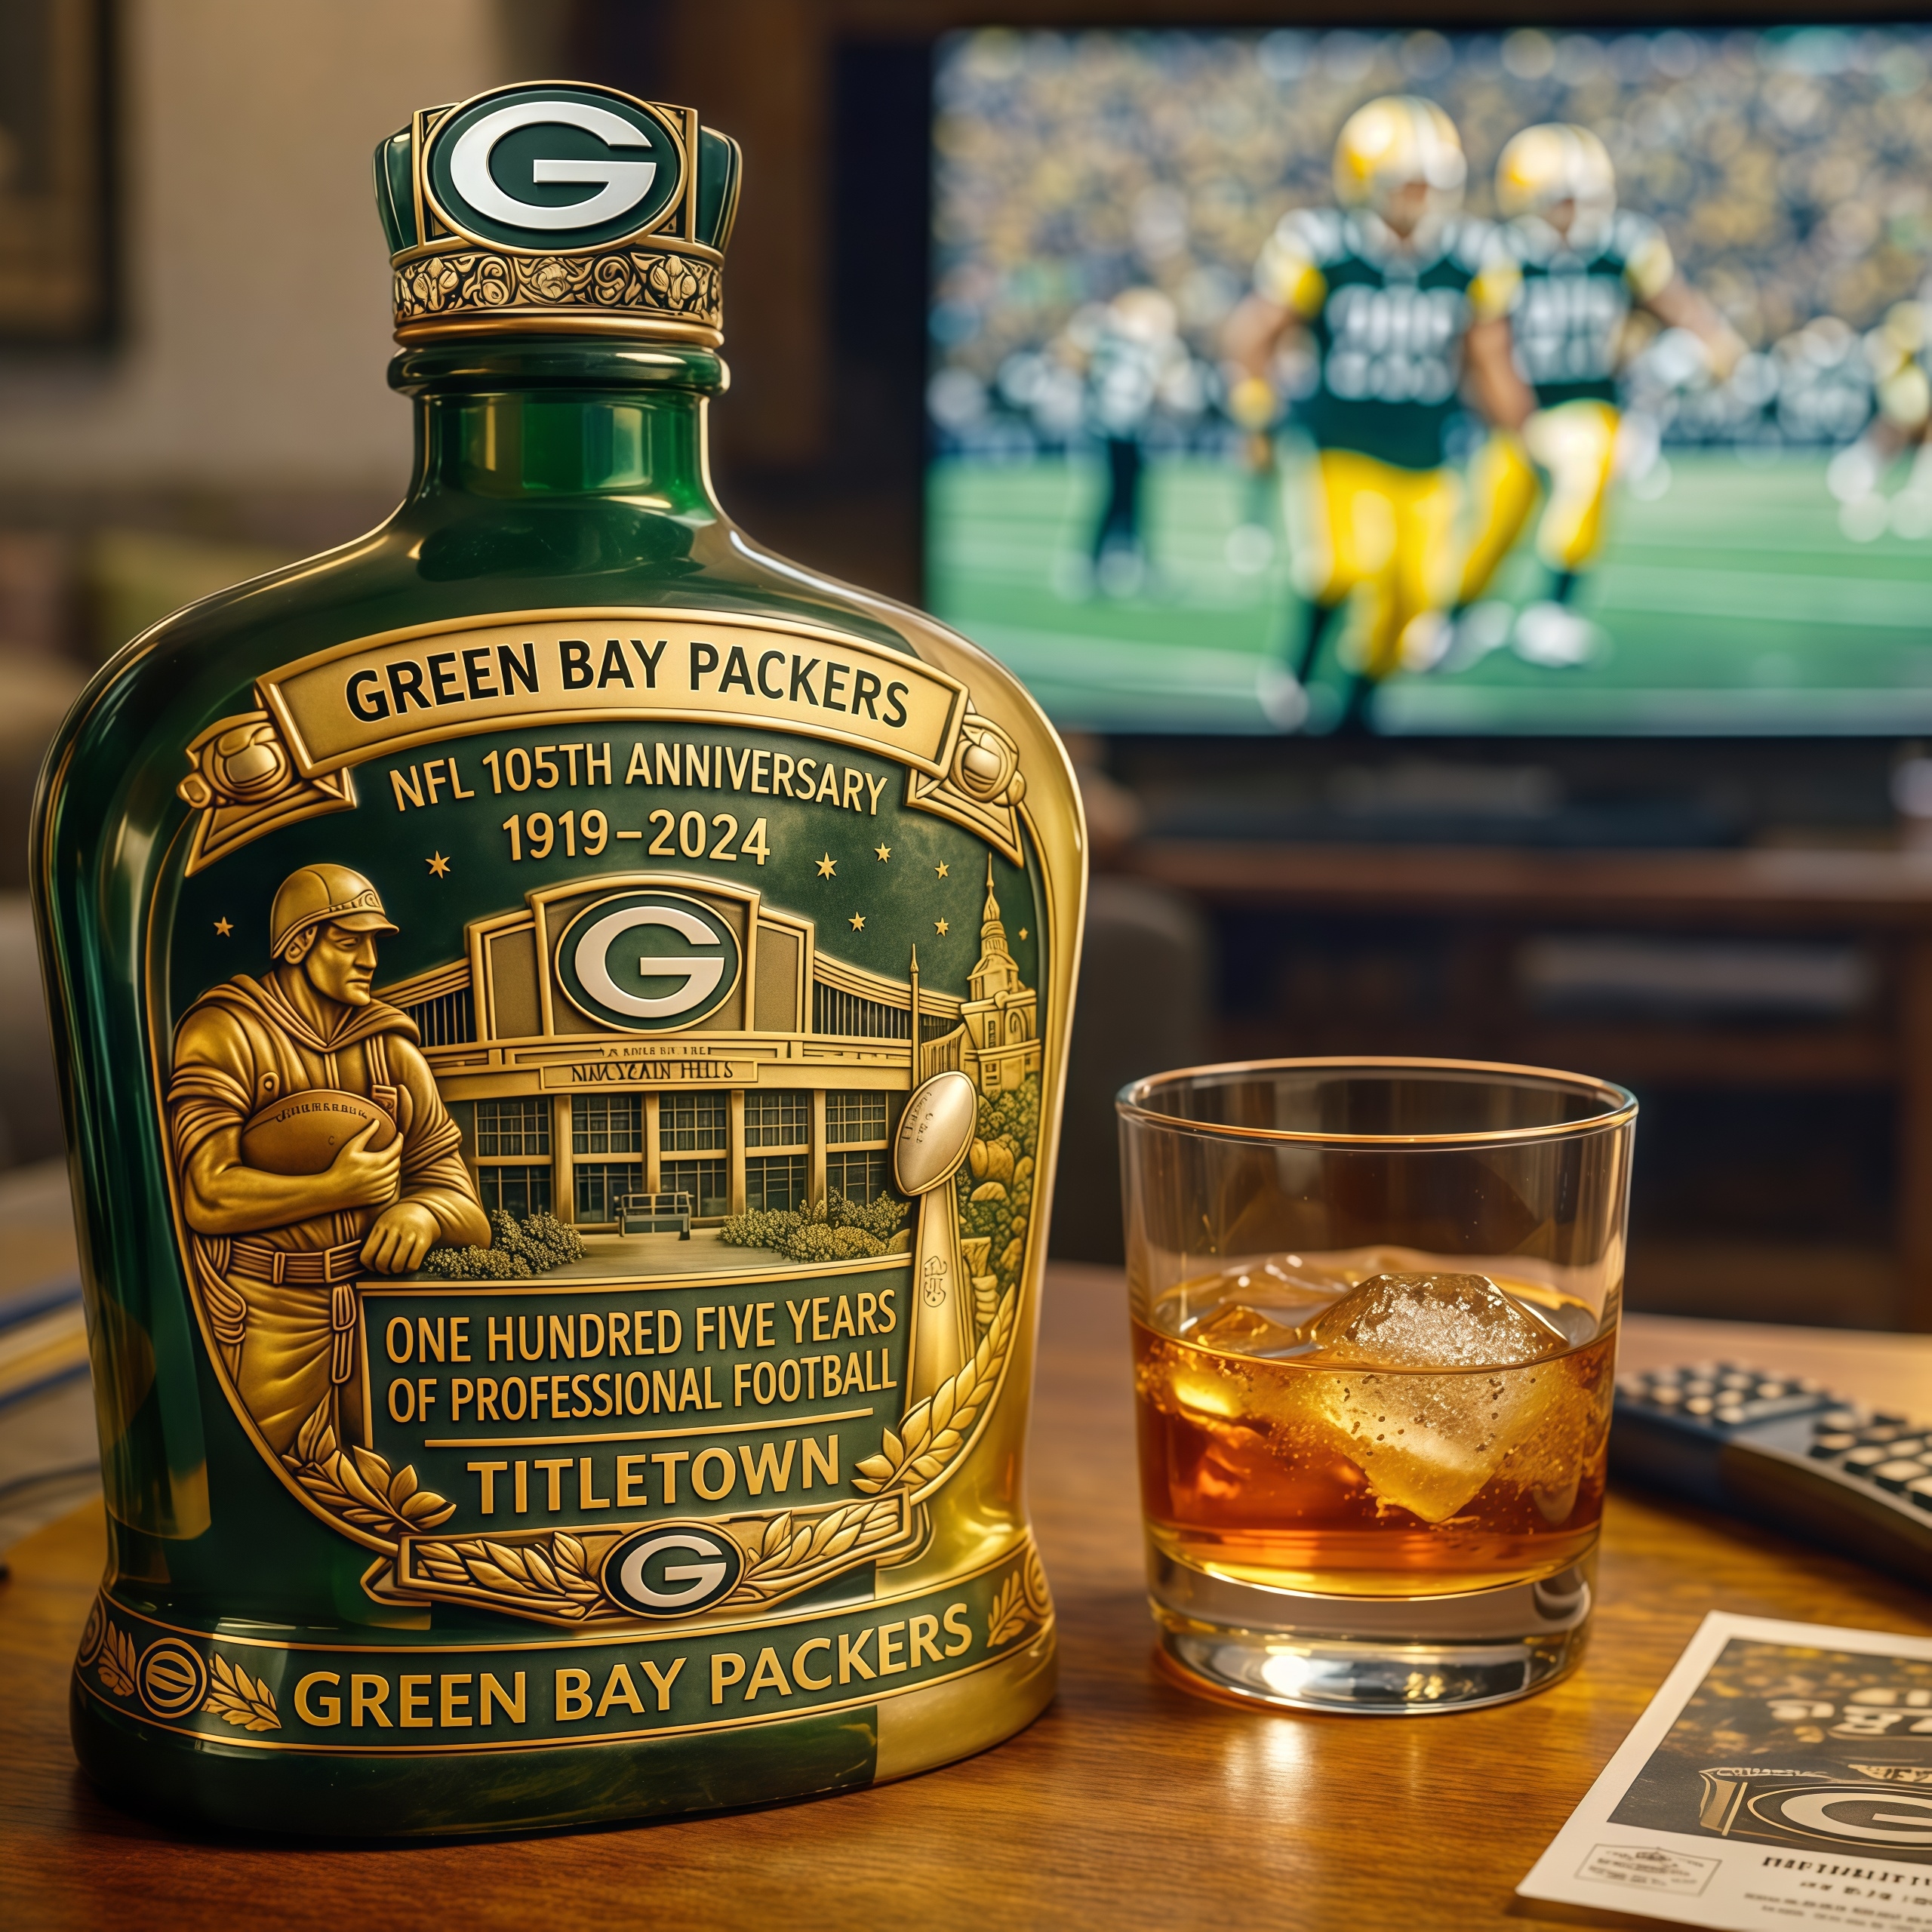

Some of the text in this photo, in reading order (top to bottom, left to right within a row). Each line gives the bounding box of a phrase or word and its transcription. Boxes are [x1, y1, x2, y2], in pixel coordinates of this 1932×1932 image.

[450, 100, 657, 229] G
[346, 639, 909, 728] GREEN BAY PACKERS
[389, 742, 888, 815] NFL 105TH ANNIVERSARY
[575, 906, 724, 1018] G
[386, 1288, 897, 1364] ONE HUNDRED FIVE YEARS
[388, 1348, 897, 1423] OF PROFESSIONAL FOOTBALL
[466, 1434, 839, 1514] TITLETOWN
[620, 1534, 727, 1607] G
[294, 1603, 973, 1727] GREEN BAY PACKERS
